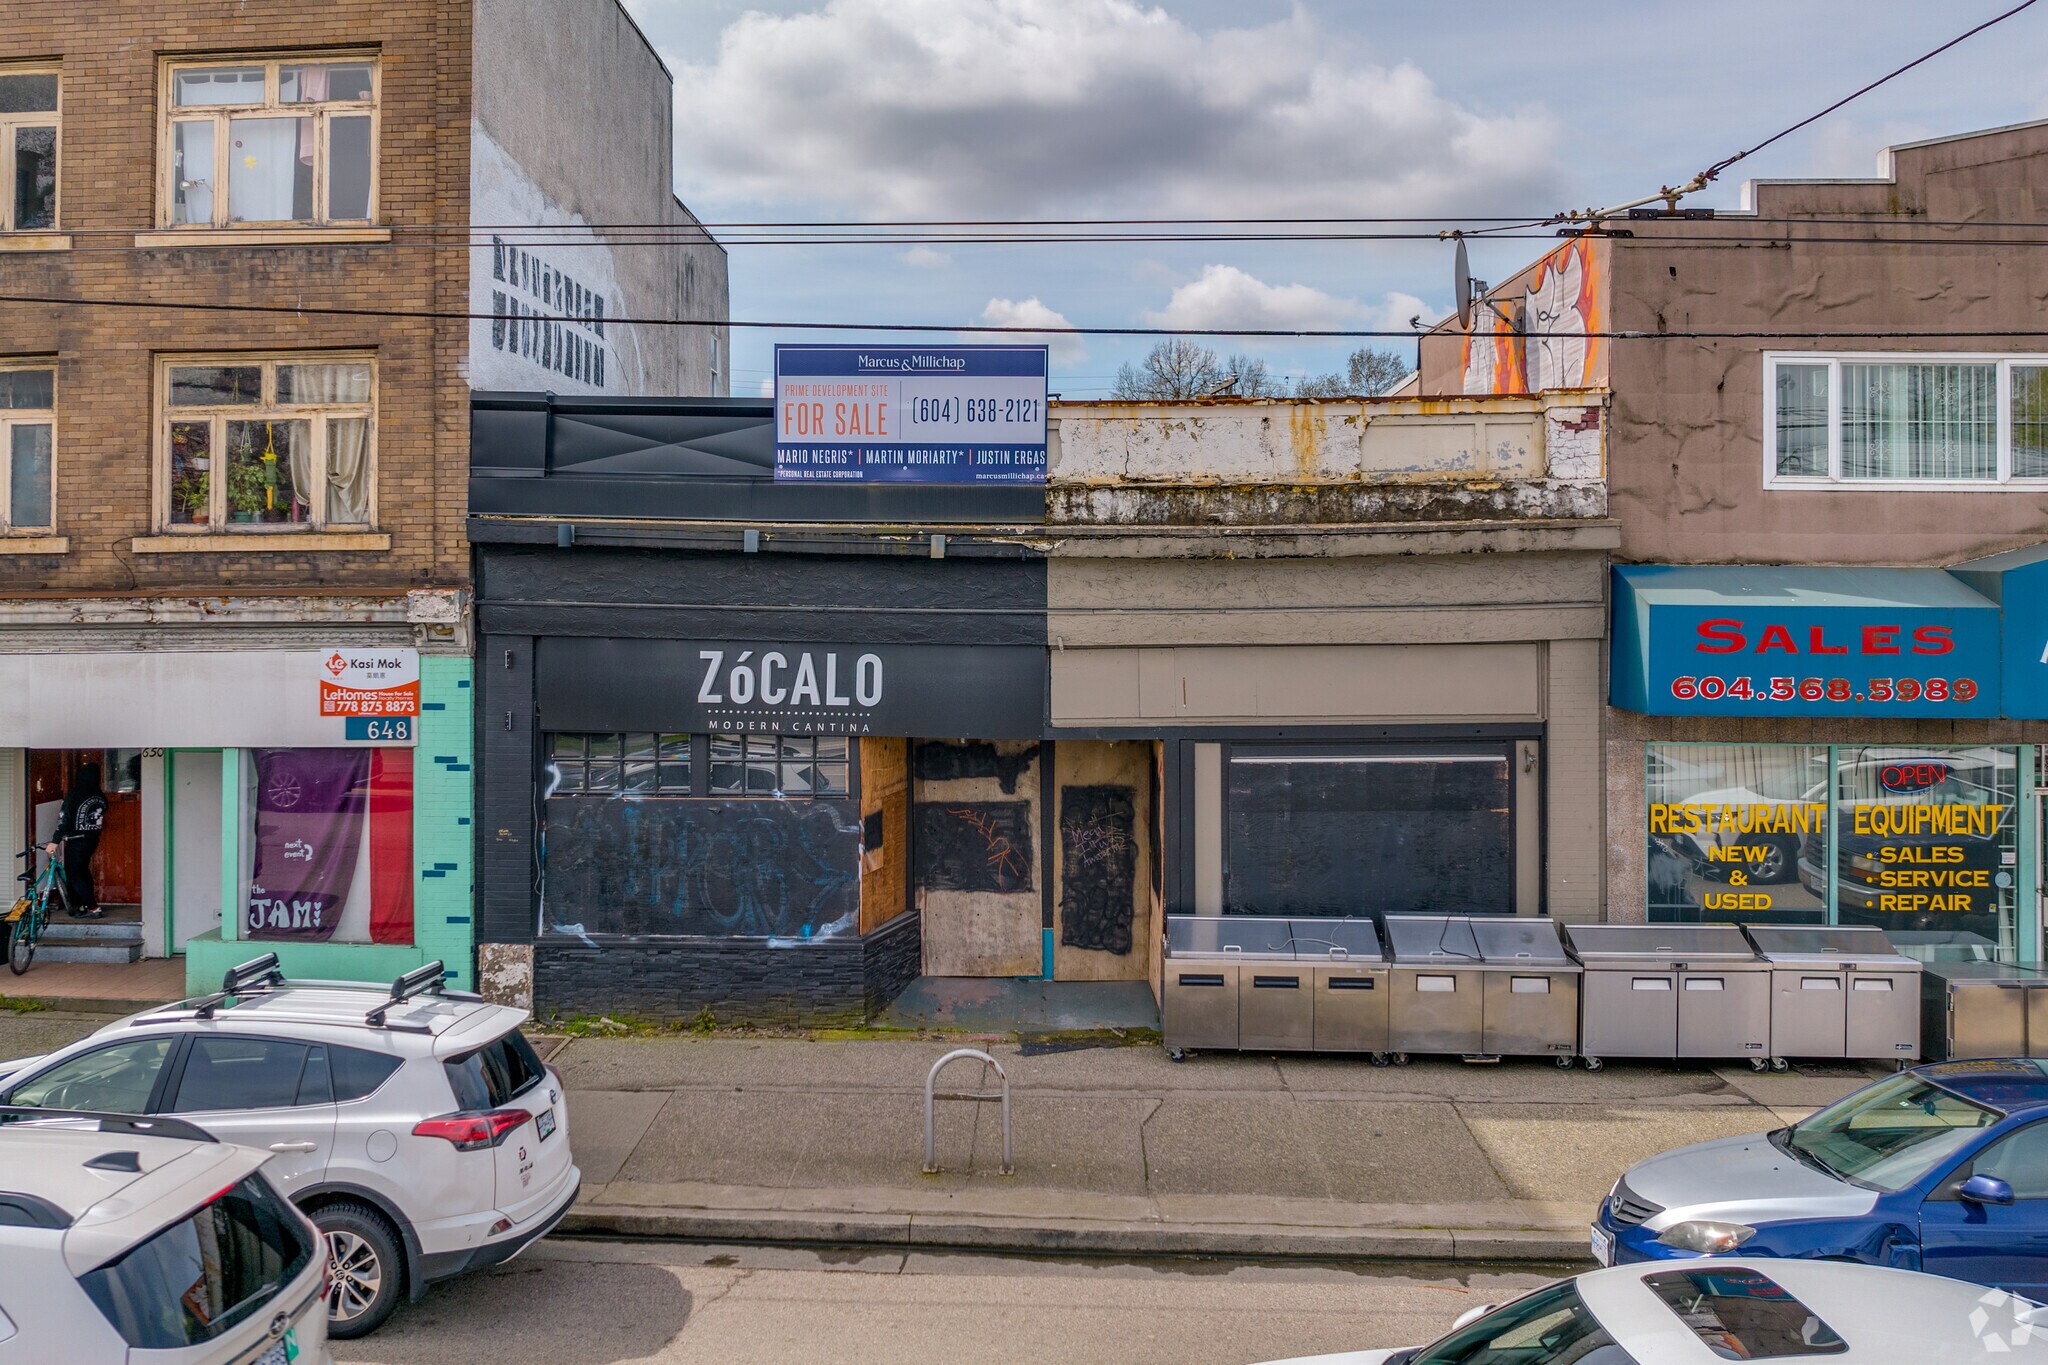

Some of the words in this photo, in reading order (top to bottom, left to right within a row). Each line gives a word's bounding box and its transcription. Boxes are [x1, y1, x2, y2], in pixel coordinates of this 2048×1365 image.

[858, 355, 900, 368] Marcus
[901, 358, 913, 371] &
[912, 354, 966, 371] Millichap
[785, 384, 809, 397] PRIME
[812, 384, 868, 397] DEVELOPMENT
[871, 384, 888, 397] SITE
[785, 402, 824, 435] FOR
[835, 402, 888, 435] SALE
[912, 396, 959, 424] (604)
[967, 398, 1038, 423] 638-2121
[777, 449, 808, 464] MARIO
[866, 450, 903, 464] MARTIN
[976, 450, 1010, 465] JUSTIN
[1014, 450, 1046, 465] ERGAS
[803, 470, 815, 478] REAL
[816, 470, 832, 478] ESTATE
[832, 470, 863, 478] CORPORATION
[1695, 618, 1956, 656] SALES
[350, 658, 374, 669] Kasi
[377, 658, 402, 669] Mok
[323, 688, 378, 701] LeHomes
[1671, 675, 1979, 703] 604.568.5989
[336, 700, 358, 712] 778
[361, 700, 383, 712] 875
[385, 700, 415, 712] 8873
[367, 720, 407, 740] 648
[709, 721, 779, 731] MODERN
[793, 722, 870, 733] CANTINA
[142, 747, 164, 758] 650
[1881, 764, 1946, 786] OPEN
[1650, 803, 1828, 834] RESTAURANT
[1854, 803, 2003, 838] EQUIPMENT
[284, 838, 302, 849] next
[284, 849, 305, 859] event
[1708, 845, 1769, 863] NEW
[1880, 846, 1965, 864] SALES
[1729, 869, 1748, 887] &
[1880, 870, 1989, 887] SERVICE
[252, 884, 266, 894] the
[1704, 892, 1772, 911] USED
[1880, 894, 1972, 911] REPAIR
